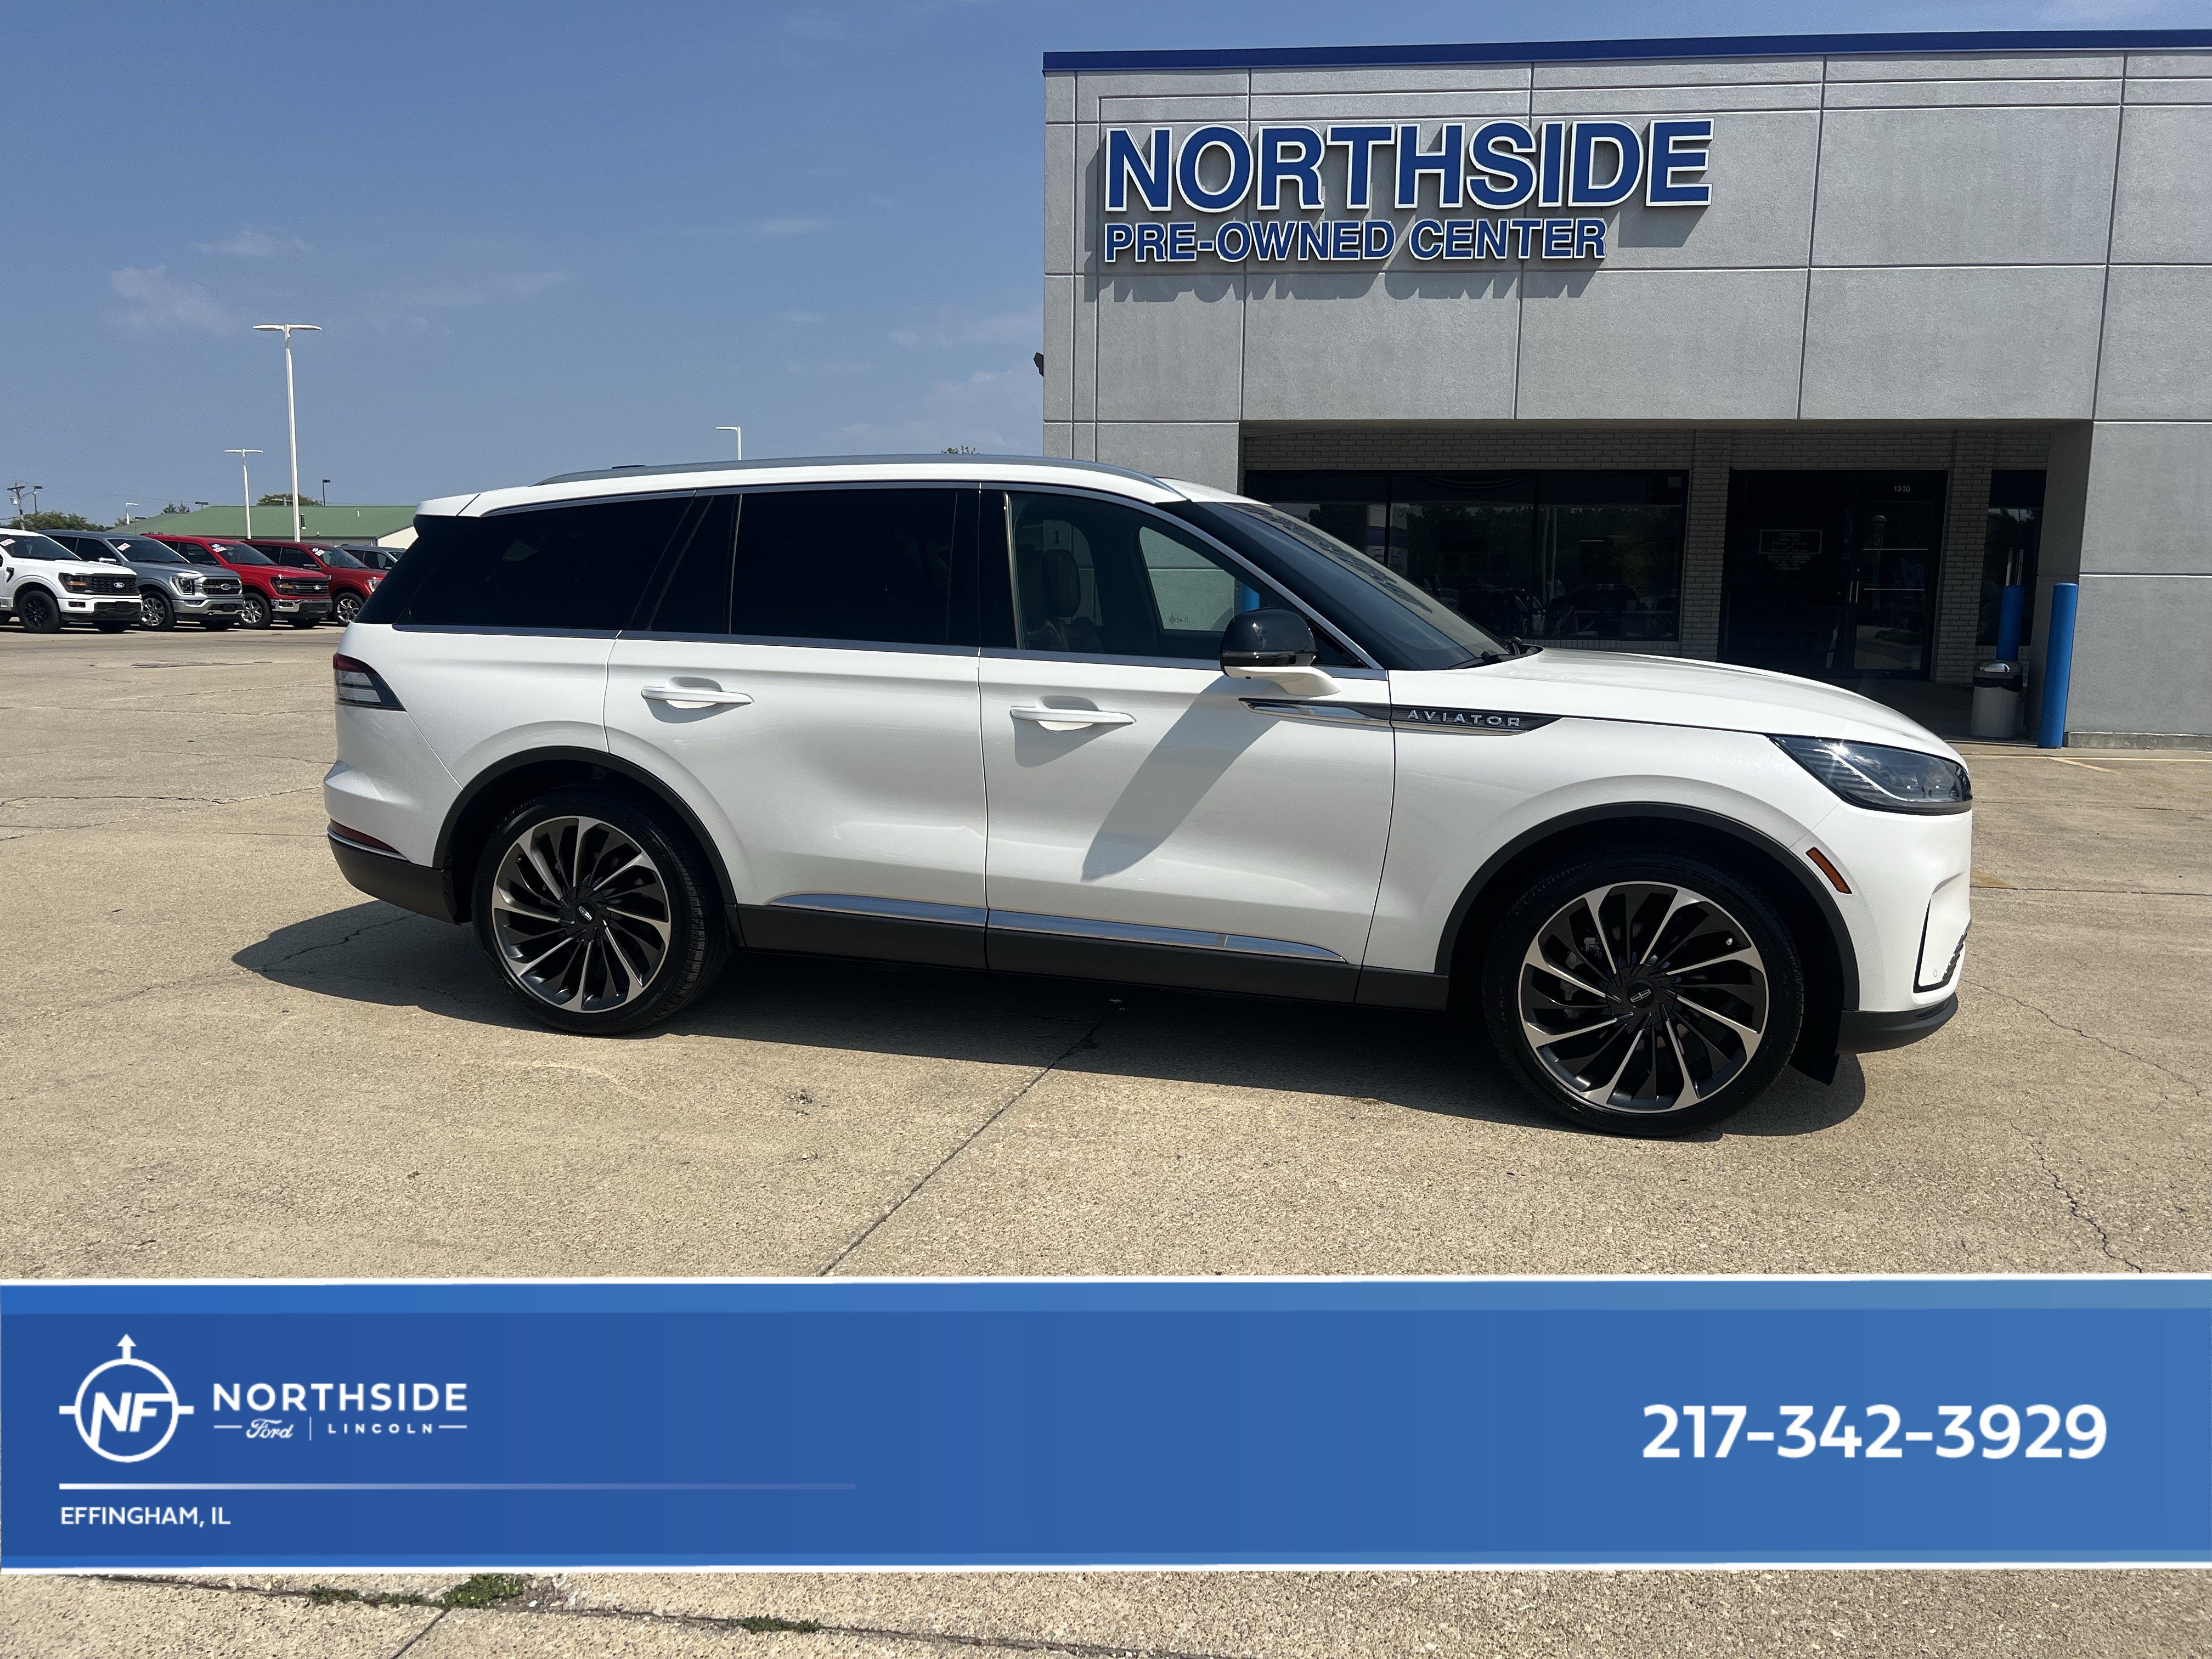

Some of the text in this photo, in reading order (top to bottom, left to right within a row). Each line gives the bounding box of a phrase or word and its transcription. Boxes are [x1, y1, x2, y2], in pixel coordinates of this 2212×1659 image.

[1105, 119, 1715, 213] NORTHSIDE
[1104, 218, 1607, 263] PRE-OWNED CENTER
[1406, 710, 1521, 726] AVIATOR
